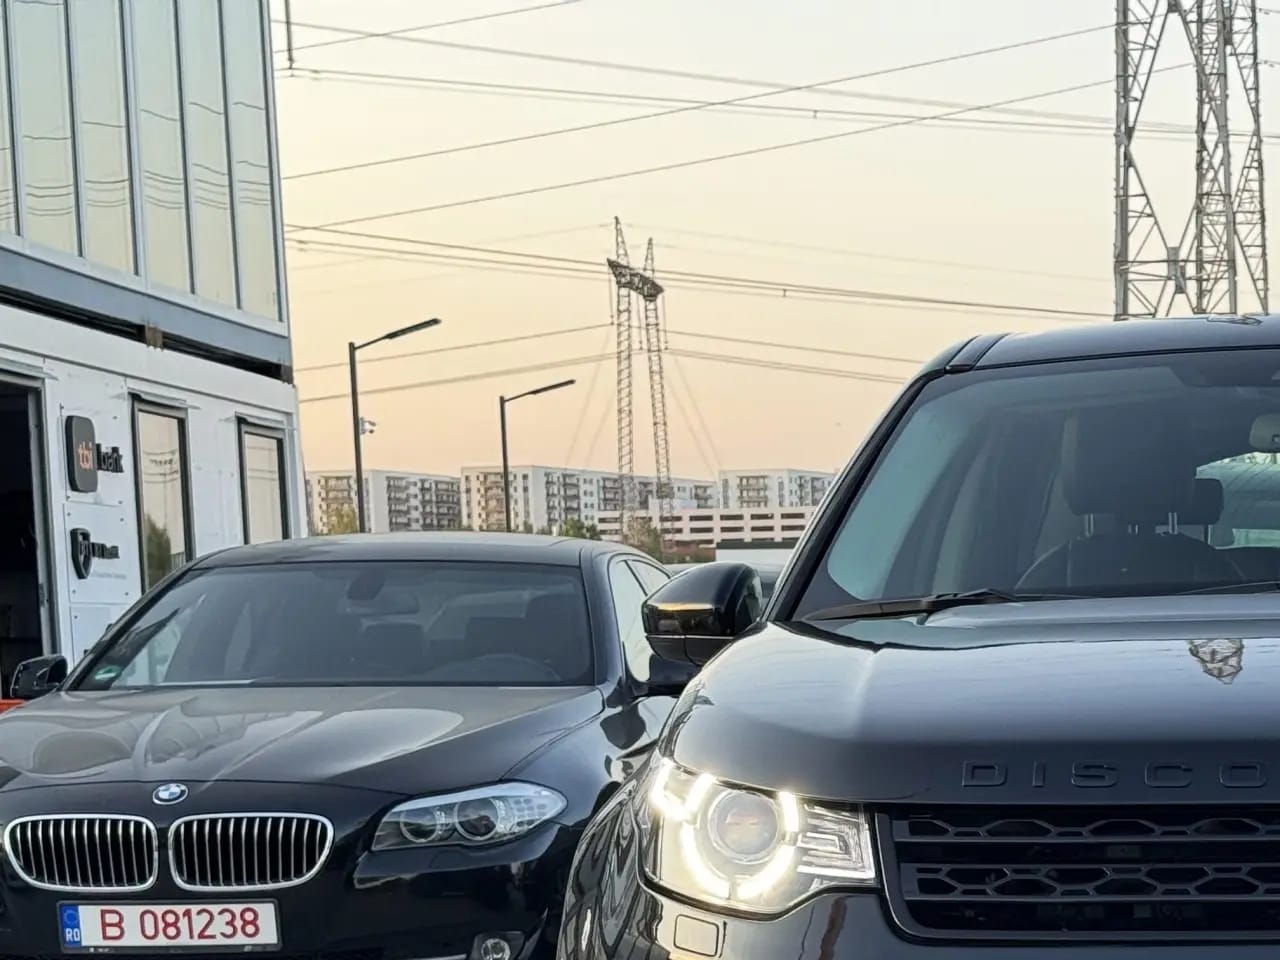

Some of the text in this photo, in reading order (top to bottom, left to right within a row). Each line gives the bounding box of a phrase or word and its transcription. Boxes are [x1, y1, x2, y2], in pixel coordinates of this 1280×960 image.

[78, 441, 94, 470] tbi
[65, 928, 80, 942] RO
[100, 907, 260, 940] B 081238
